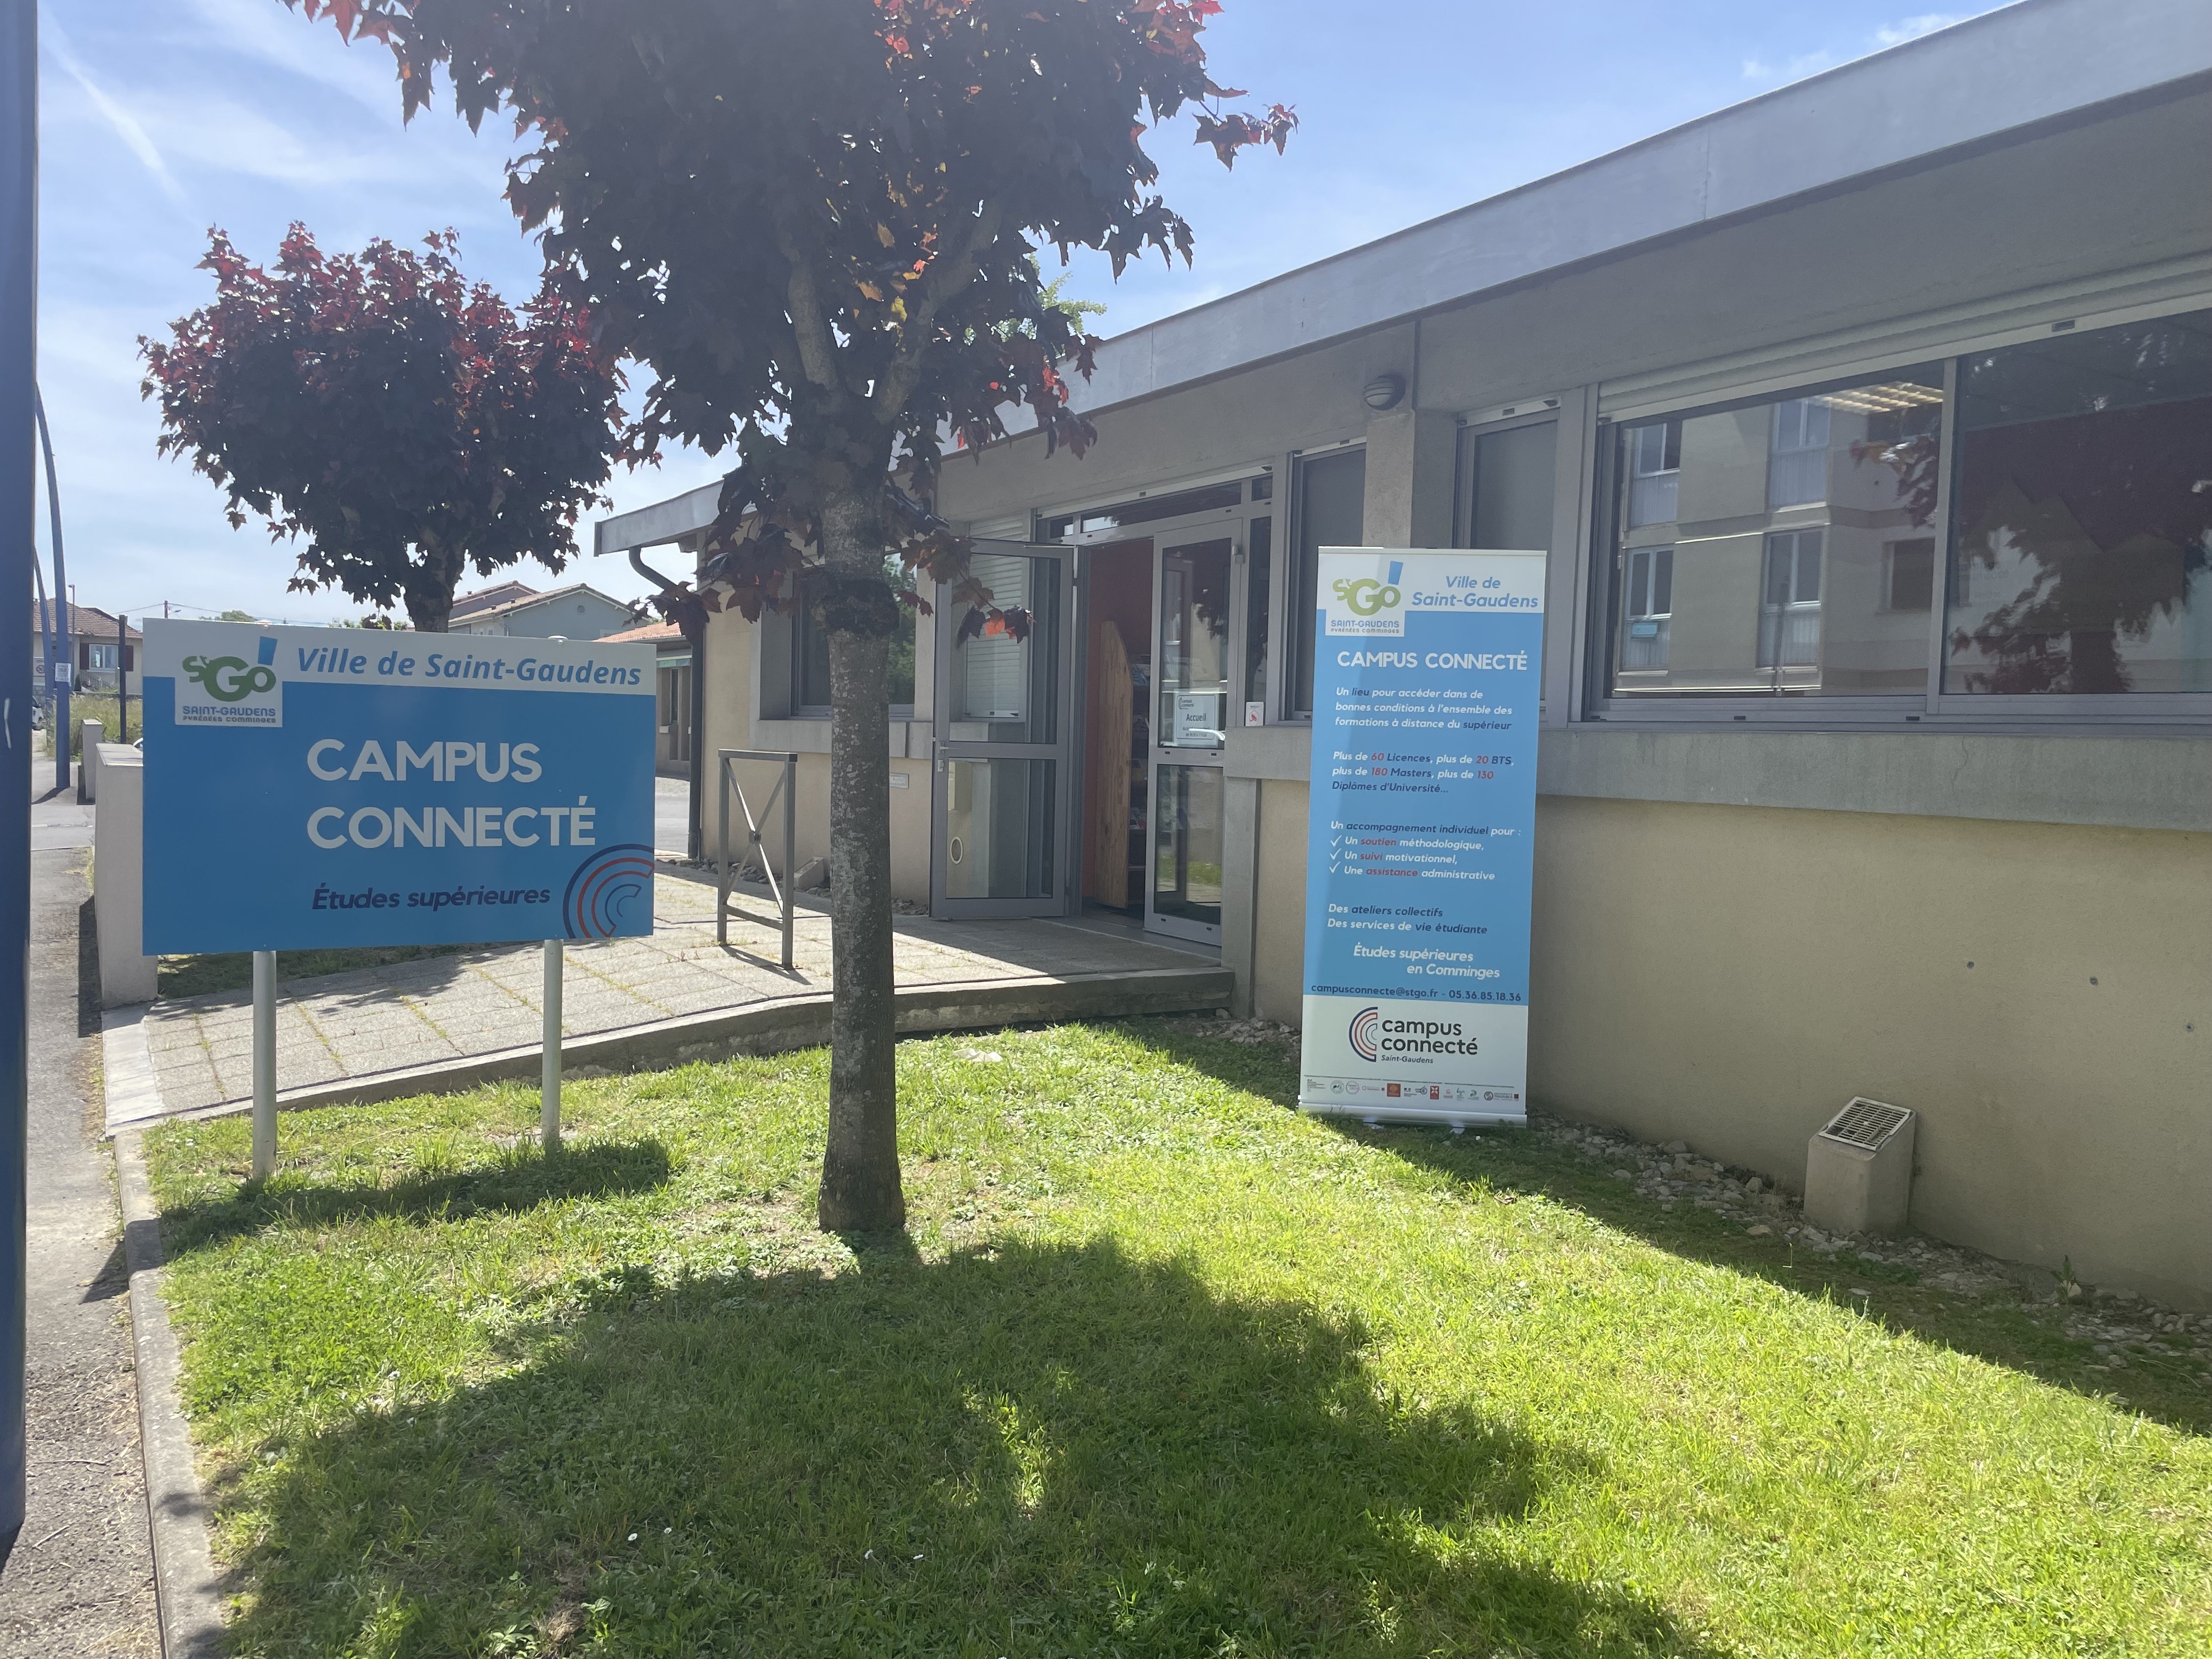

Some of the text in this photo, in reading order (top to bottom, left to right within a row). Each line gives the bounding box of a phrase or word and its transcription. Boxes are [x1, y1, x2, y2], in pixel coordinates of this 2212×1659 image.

[1446, 576, 1500, 589] Ville de
[1412, 592, 1538, 608] Saint-Gaudens
[298, 647, 641, 686] Ville de Saint-Gaudens
[1337, 650, 1527, 670] CAMPUS CONNECTÉ
[1336, 687, 1483, 699] Un lieu pour accéder dans de
[183, 706, 276, 717] SAINT-GAUDENS
[1335, 702, 1371, 712] bonnes
[1374, 703, 1425, 713] conditions
[1427, 704, 1435, 713] à
[1494, 706, 1512, 714] des
[1186, 713, 1206, 721] Accueil
[1335, 716, 1512, 730] formations à distance du supérieur
[306, 738, 542, 783] CAMPUS
[1333, 751, 1514, 766] Plus de 60 Licences, plus de 20 BTS,
[1331, 767, 1352, 776] plus
[1355, 766, 1368, 776] de
[1371, 768, 1388, 776] 180
[1390, 768, 1434, 778] Masters,
[1437, 769, 1458, 780] plus
[1461, 770, 1474, 778] de
[1332, 781, 1377, 791] Diplômes
[307, 795, 596, 849] CONNECTÉ
[1330, 821, 1343, 830] Un
[1346, 823, 1437, 833] accompagnement
[1439, 825, 1488, 834] individuel
[1491, 828, 1515, 837] pour
[1345, 836, 1485, 851] Un soutien méthodologique,
[1345, 851, 1458, 865] Un suivi motivationnel,
[1344, 866, 1495, 880] Une assistance administrative
[312, 883, 551, 912] Études supérieures
[1328, 904, 1443, 917] Des ateliers collectifs
[1327, 918, 1488, 934] Des services de vie étudiante
[1353, 942, 1474, 962] Études supérieures
[1407, 963, 1500, 980] en Comminges
[1311, 985, 1438, 998] campusconnecte@stgo.fr
[1449, 990, 1521, 1001] 05.36.85.18.36
[1382, 1019, 1462, 1039] campus
[1381, 1037, 1478, 1056] connecté
[1381, 1054, 1434, 1064] Saint-Gaudens
